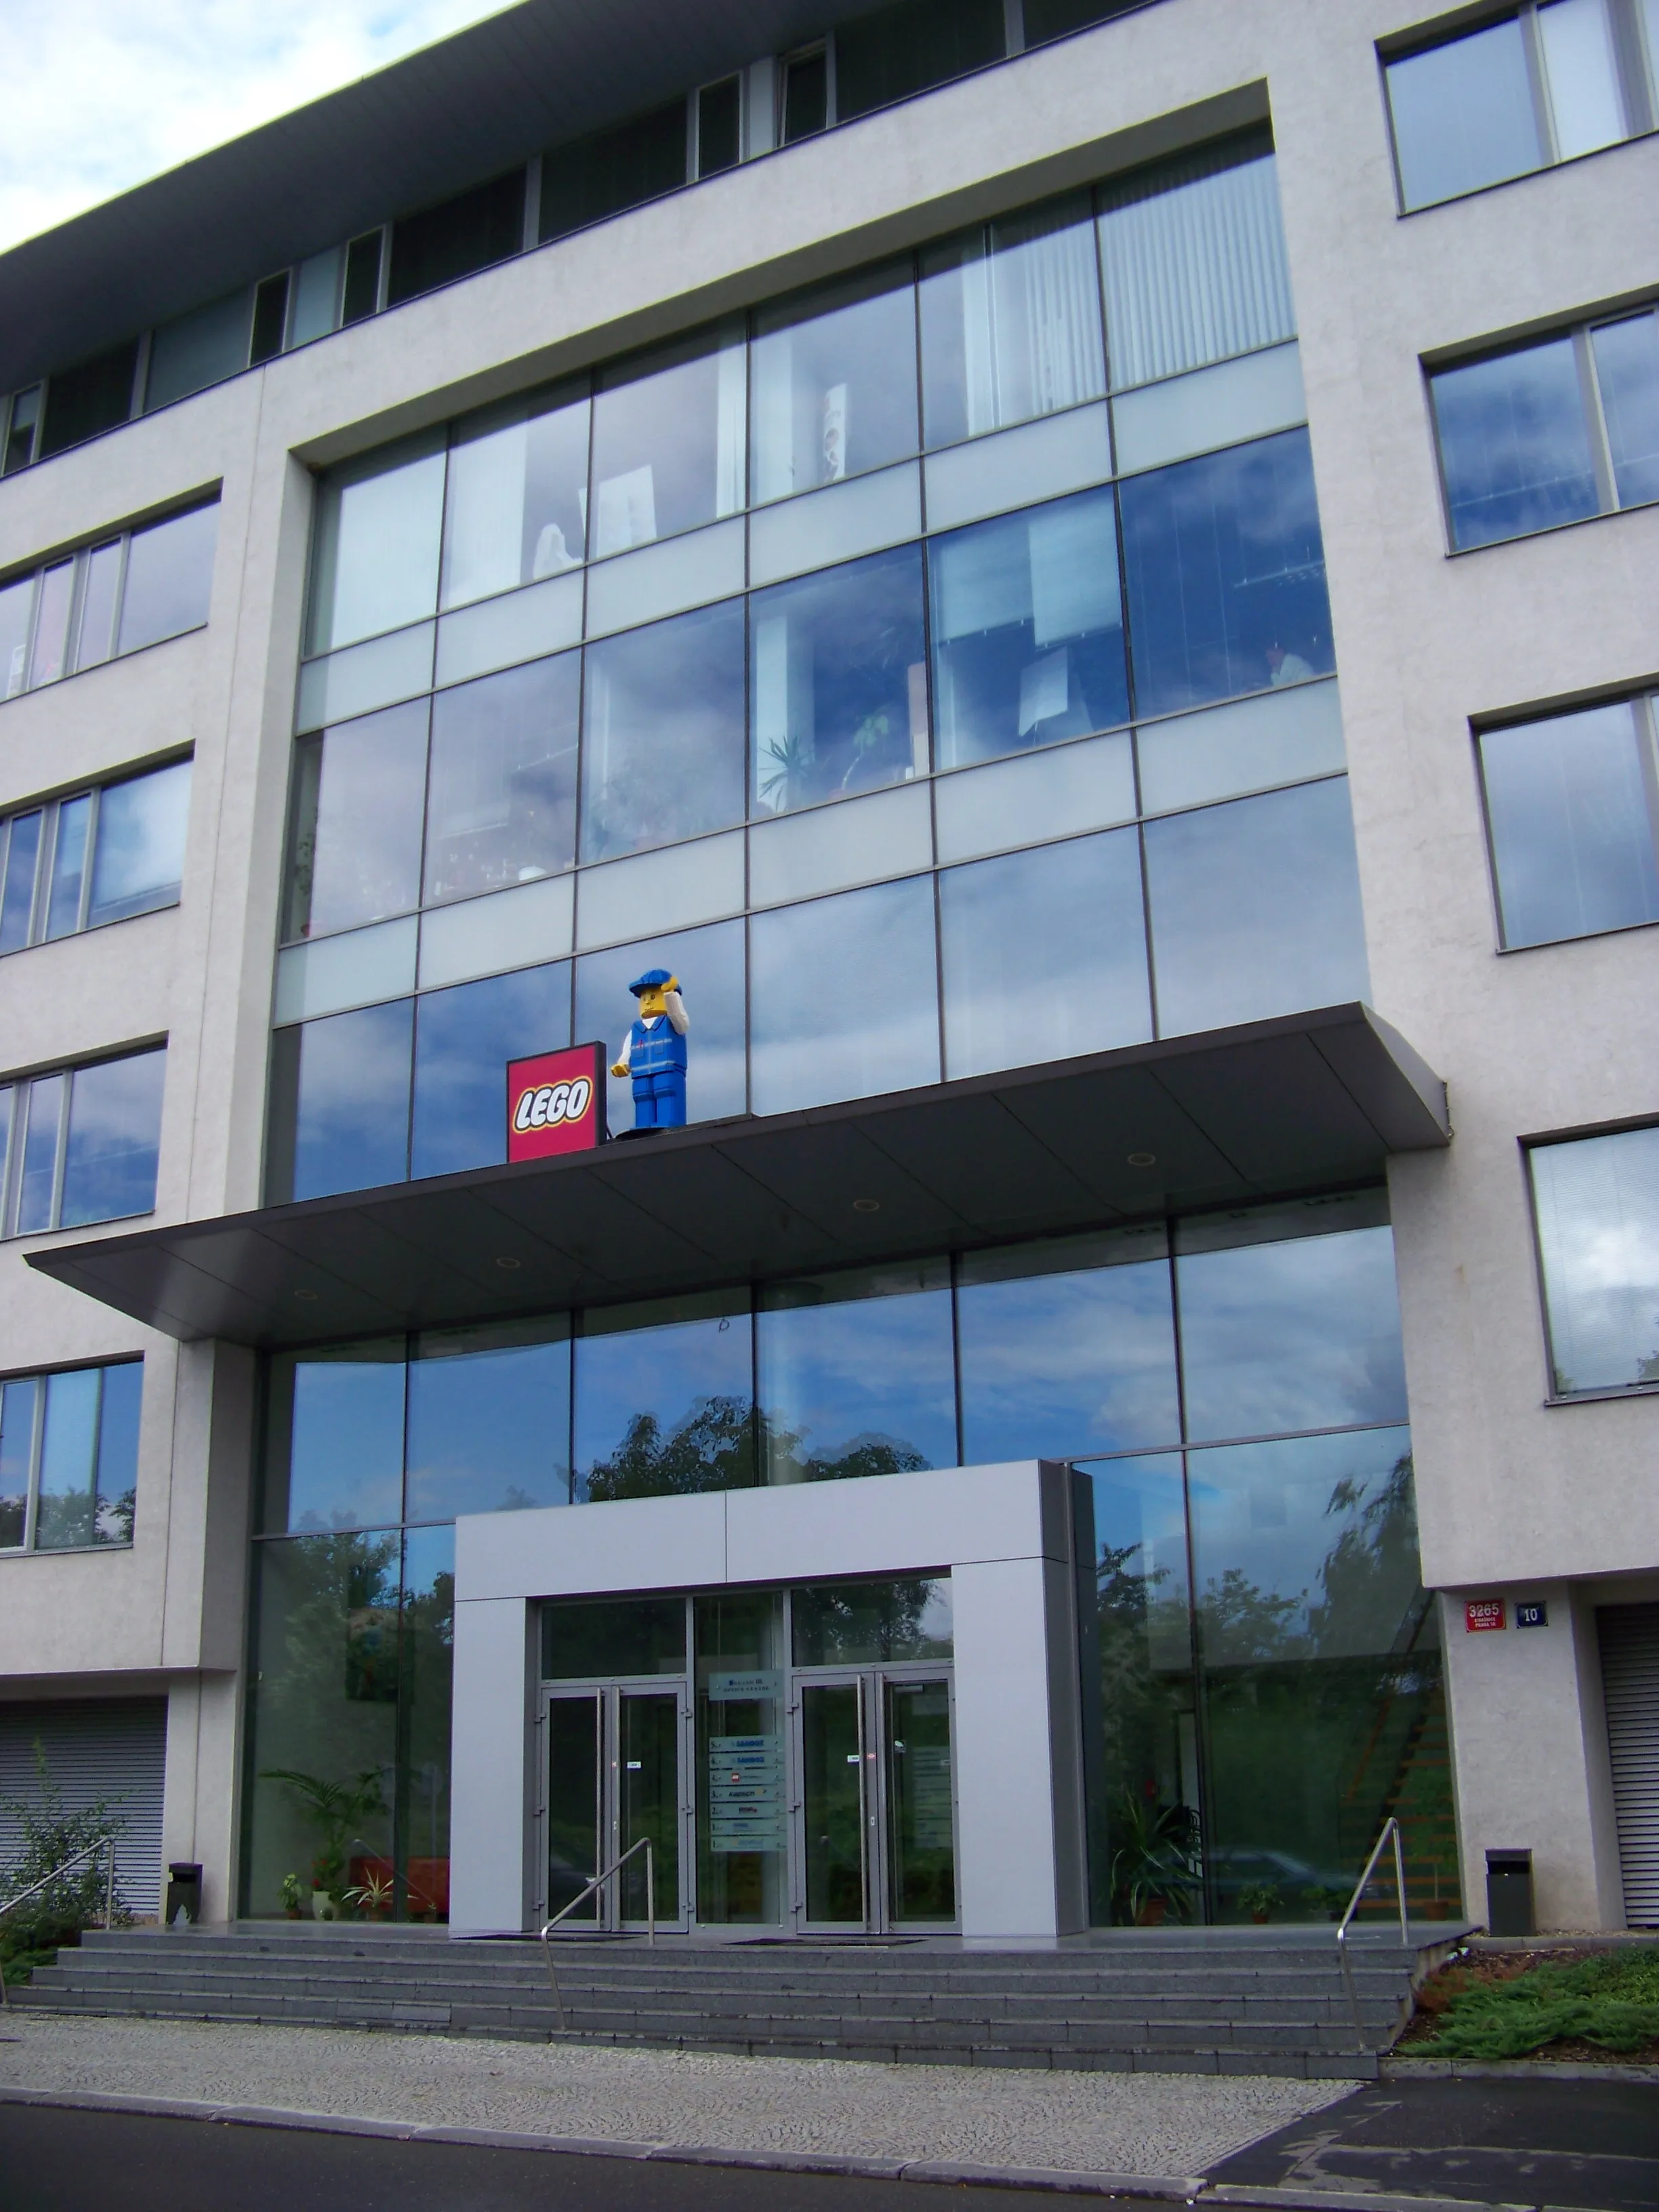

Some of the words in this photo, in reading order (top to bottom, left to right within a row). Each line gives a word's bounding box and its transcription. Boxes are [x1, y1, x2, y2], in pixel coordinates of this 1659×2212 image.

[515, 1079, 590, 1130] LEGO
[1469, 1603, 1499, 1618] 3265
[1525, 1608, 1538, 1621] 10
